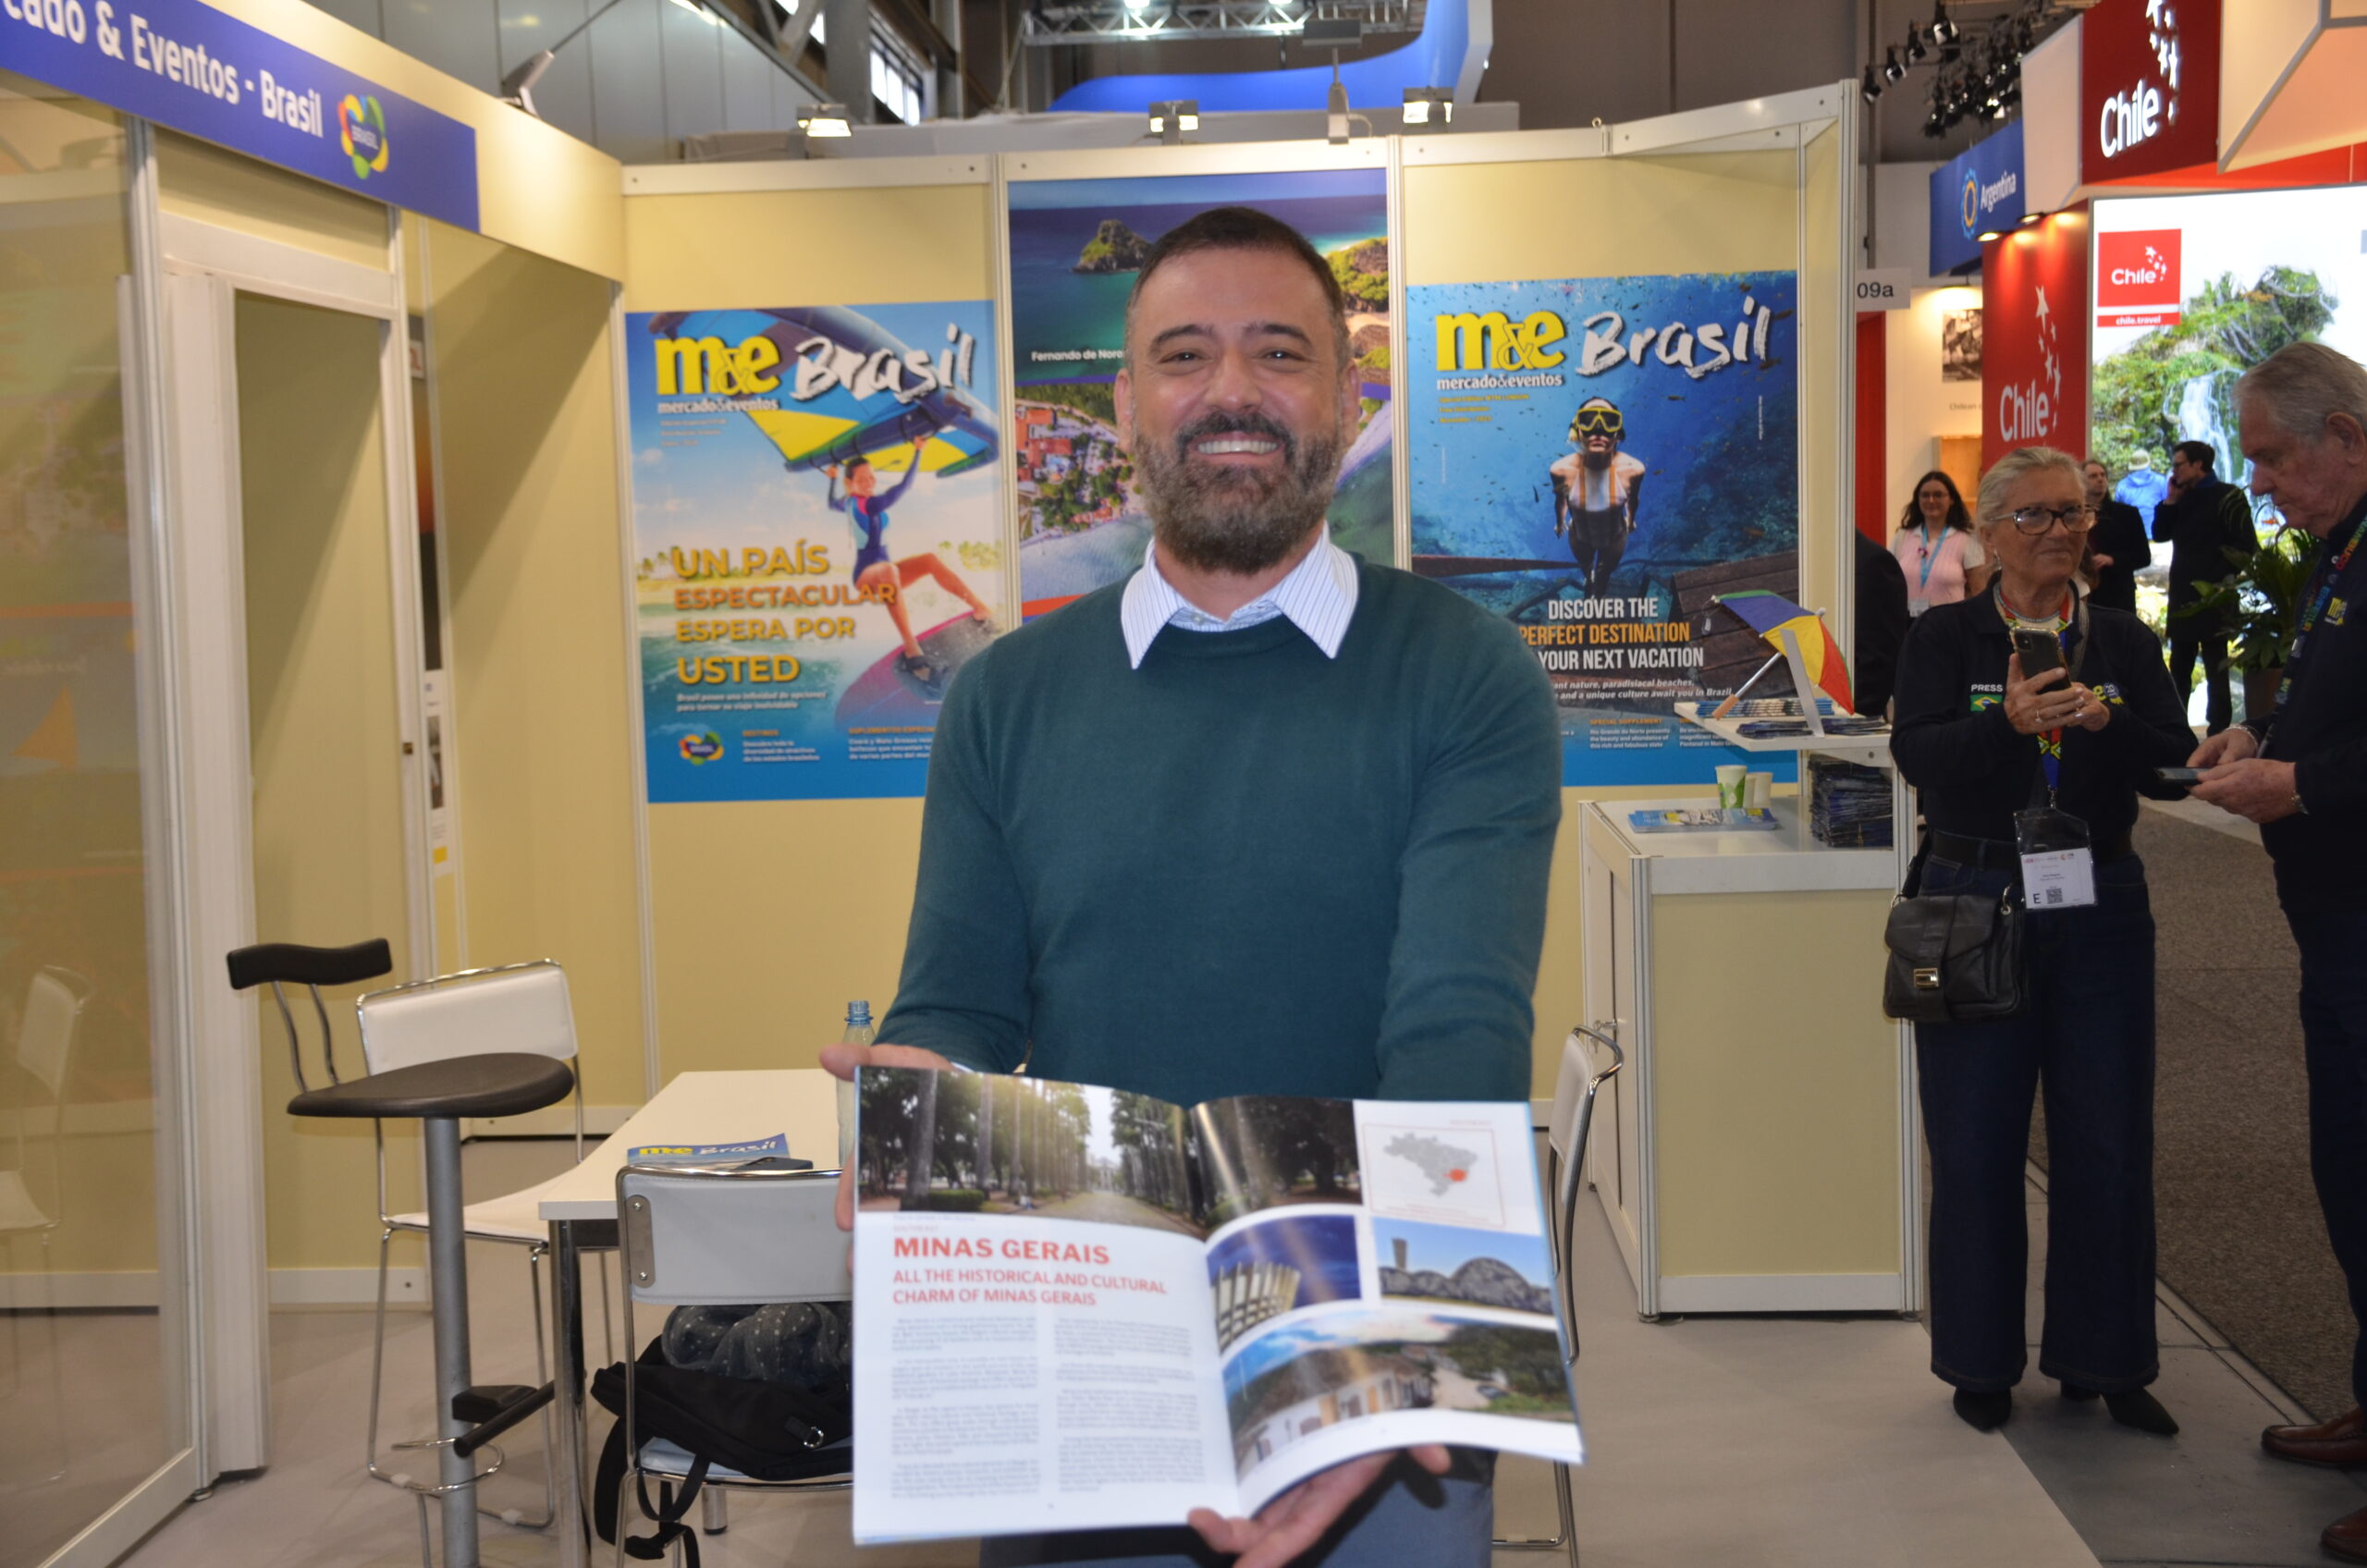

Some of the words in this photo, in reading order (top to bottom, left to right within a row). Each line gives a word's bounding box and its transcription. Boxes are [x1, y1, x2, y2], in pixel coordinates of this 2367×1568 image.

[94, 0, 126, 61] &
[130, 13, 240, 104] Eventos
[260, 69, 324, 138] Brasil
[2101, 79, 2160, 158] Chile
[1981, 170, 2017, 213] Argentina
[2111, 267, 2157, 286] Chile
[1857, 281, 1894, 300] 09a
[2116, 315, 2162, 325] chile.travel
[1575, 296, 1772, 379] Brasil
[790, 323, 976, 404] Brasil
[1031, 350, 1082, 361] Fernando
[1083, 349, 1097, 360] de
[1098, 349, 1125, 360] Noro
[1436, 374, 1564, 390] mercado&eventos
[1999, 380, 2050, 443] Chile
[672, 547, 729, 579] UN
[741, 539, 829, 577] PAÍS
[673, 583, 898, 611] ESPECTACULAR
[1548, 597, 1625, 620] DISCOVER
[1627, 596, 1659, 618] THE
[675, 619, 788, 643] ESPERA
[793, 616, 856, 640] POR
[1518, 625, 1586, 646] PERFECT
[1588, 621, 1690, 644] DESTINATION
[677, 655, 802, 685] USTED
[1538, 649, 1579, 671] YOUR
[1582, 649, 1625, 670] NEXT
[1627, 647, 1704, 669] VACATION
[1560, 691, 1577, 700] and
[1586, 691, 1616, 701] unique
[1618, 690, 1650, 699] culture
[1650, 689, 1675, 698] await
[1676, 690, 1693, 698] you
[1696, 688, 1704, 696] in
[1569, 680, 1600, 690] nature,
[1602, 679, 1655, 690] paradisiacal
[1656, 678, 1695, 688] beaches,
[1970, 684, 2004, 692] PRESS
[2032, 892, 2042, 905] E
[700, 1141, 779, 1156] Brasil
[893, 1237, 994, 1258] MINAS
[1001, 1239, 1111, 1265] GERAIS
[893, 1270, 921, 1285] ALL
[925, 1268, 954, 1283] THE
[959, 1269, 1051, 1285] HISTORICAL
[1054, 1271, 1088, 1287] AND
[1091, 1275, 1168, 1294] CULTURAL
[893, 1290, 955, 1305] CHARM
[959, 1290, 980, 1303] OF
[984, 1289, 1036, 1304] MINAS
[1041, 1291, 1097, 1306] GERAIS
